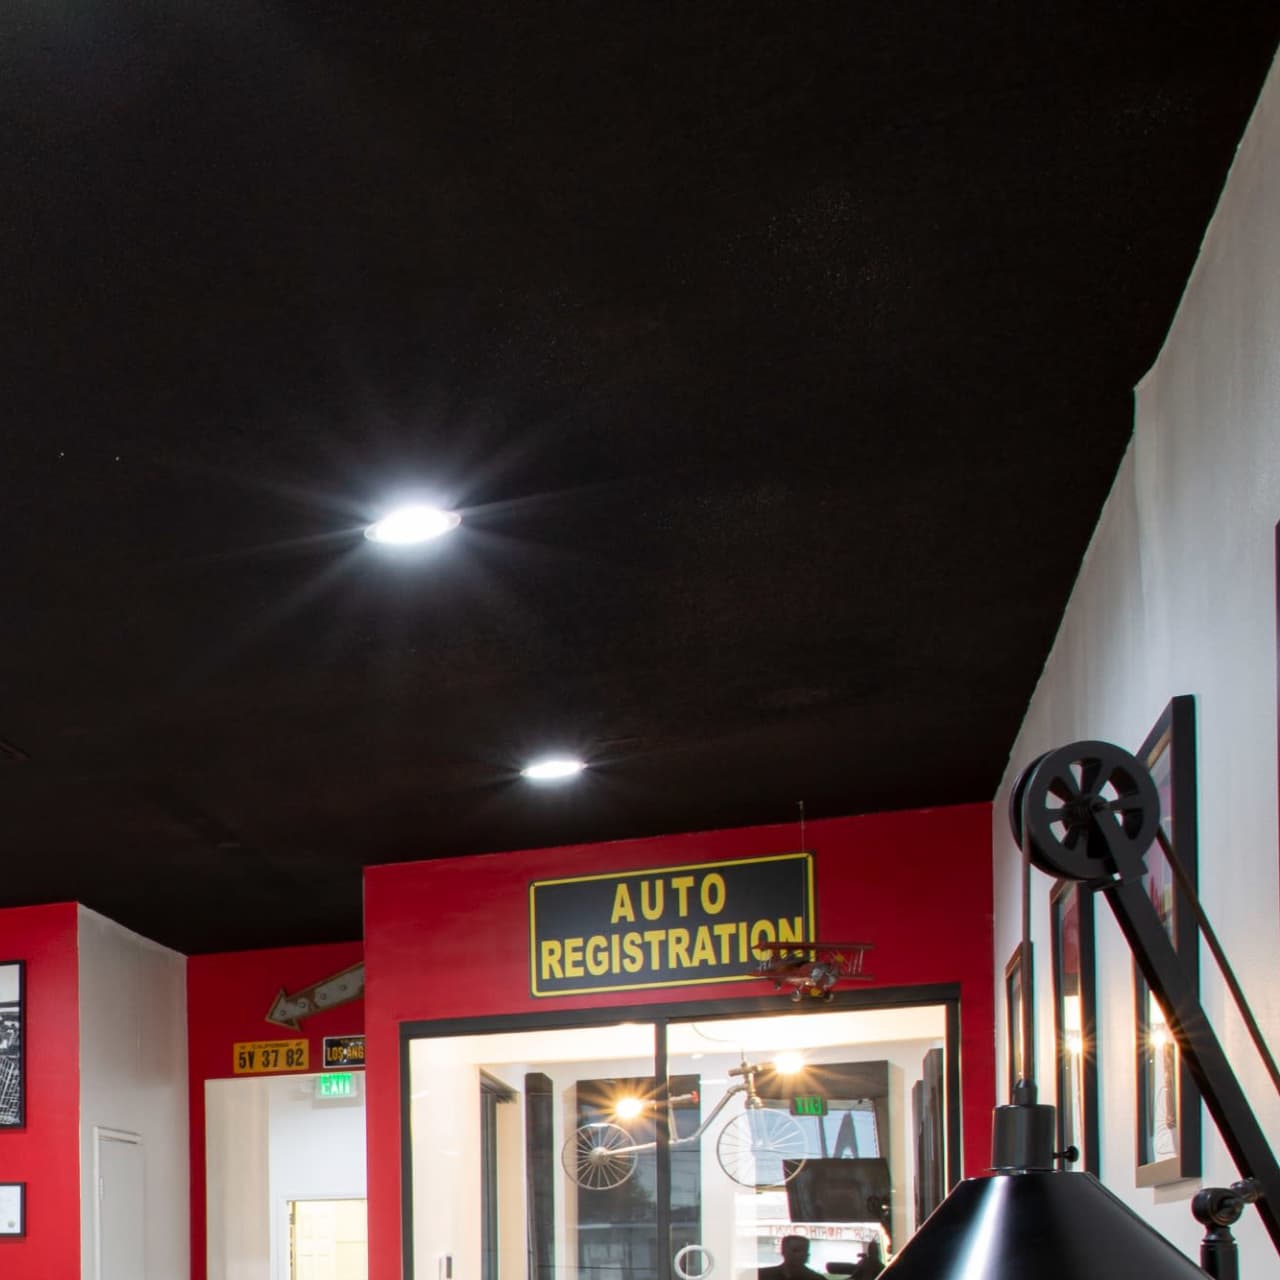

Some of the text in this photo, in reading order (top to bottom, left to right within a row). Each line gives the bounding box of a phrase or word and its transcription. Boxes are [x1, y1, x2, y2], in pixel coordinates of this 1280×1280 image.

[610, 873, 726, 924] AUTO
[541, 917, 803, 980] REGISTRATION
[262, 1049, 279, 1068] 37
[286, 1047, 304, 1067] 82
[327, 1046, 343, 1061] LOS
[321, 1073, 352, 1096] EXIT
